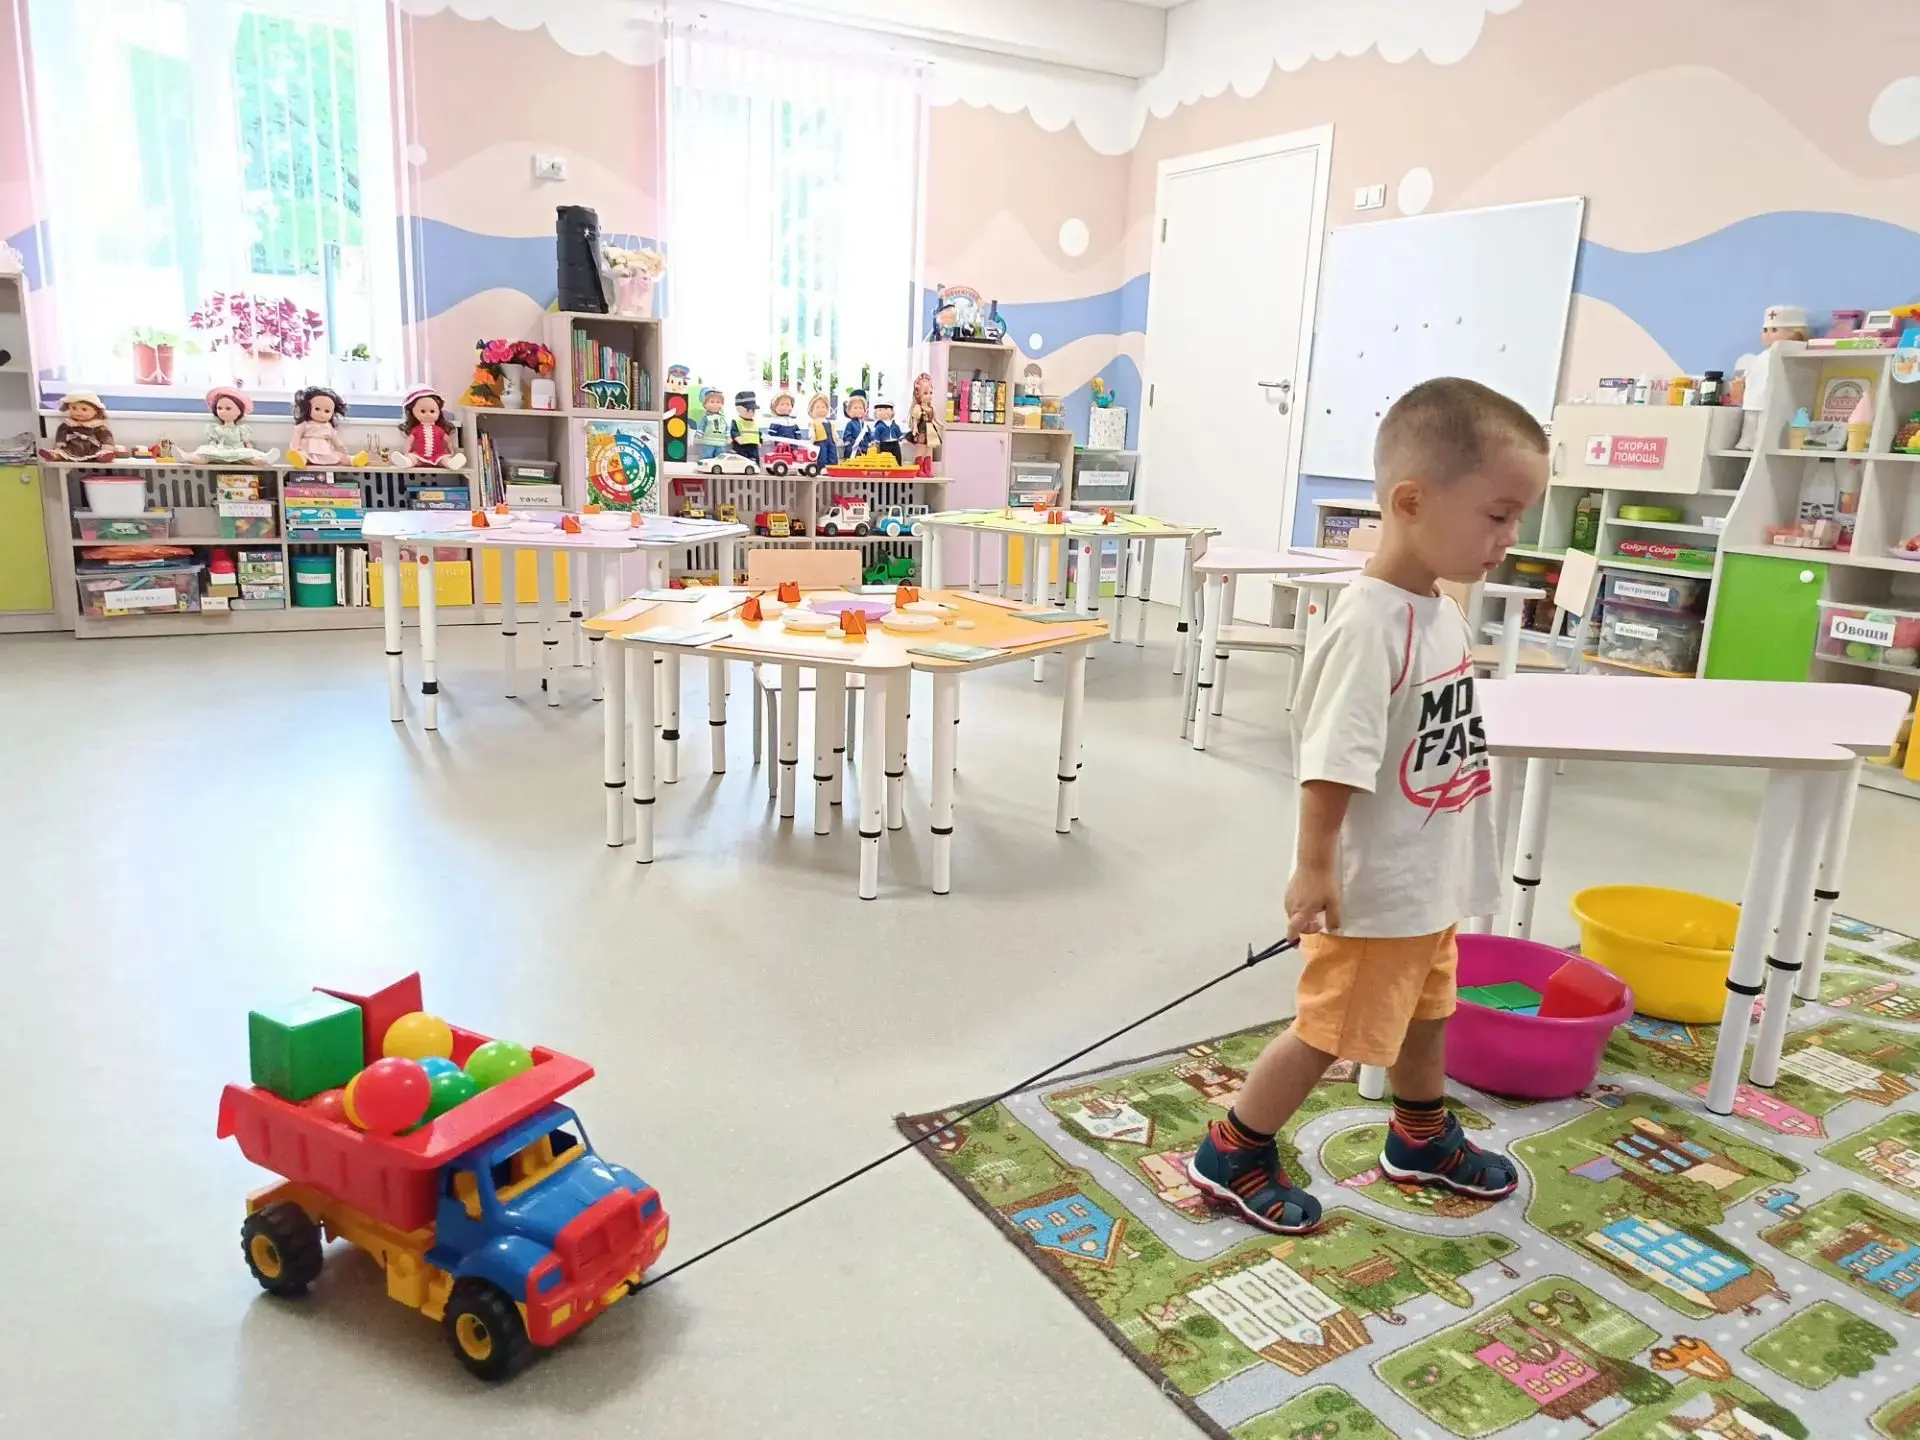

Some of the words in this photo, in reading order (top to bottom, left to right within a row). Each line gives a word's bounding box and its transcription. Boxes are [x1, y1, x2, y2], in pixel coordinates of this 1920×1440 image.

[1617, 441, 1657, 452] СКОРАЯ
[1613, 452, 1660, 464] ПОМОЩЬ
[1618, 583, 1667, 598] Инструменты
[1835, 621, 1889, 641] Овощи
